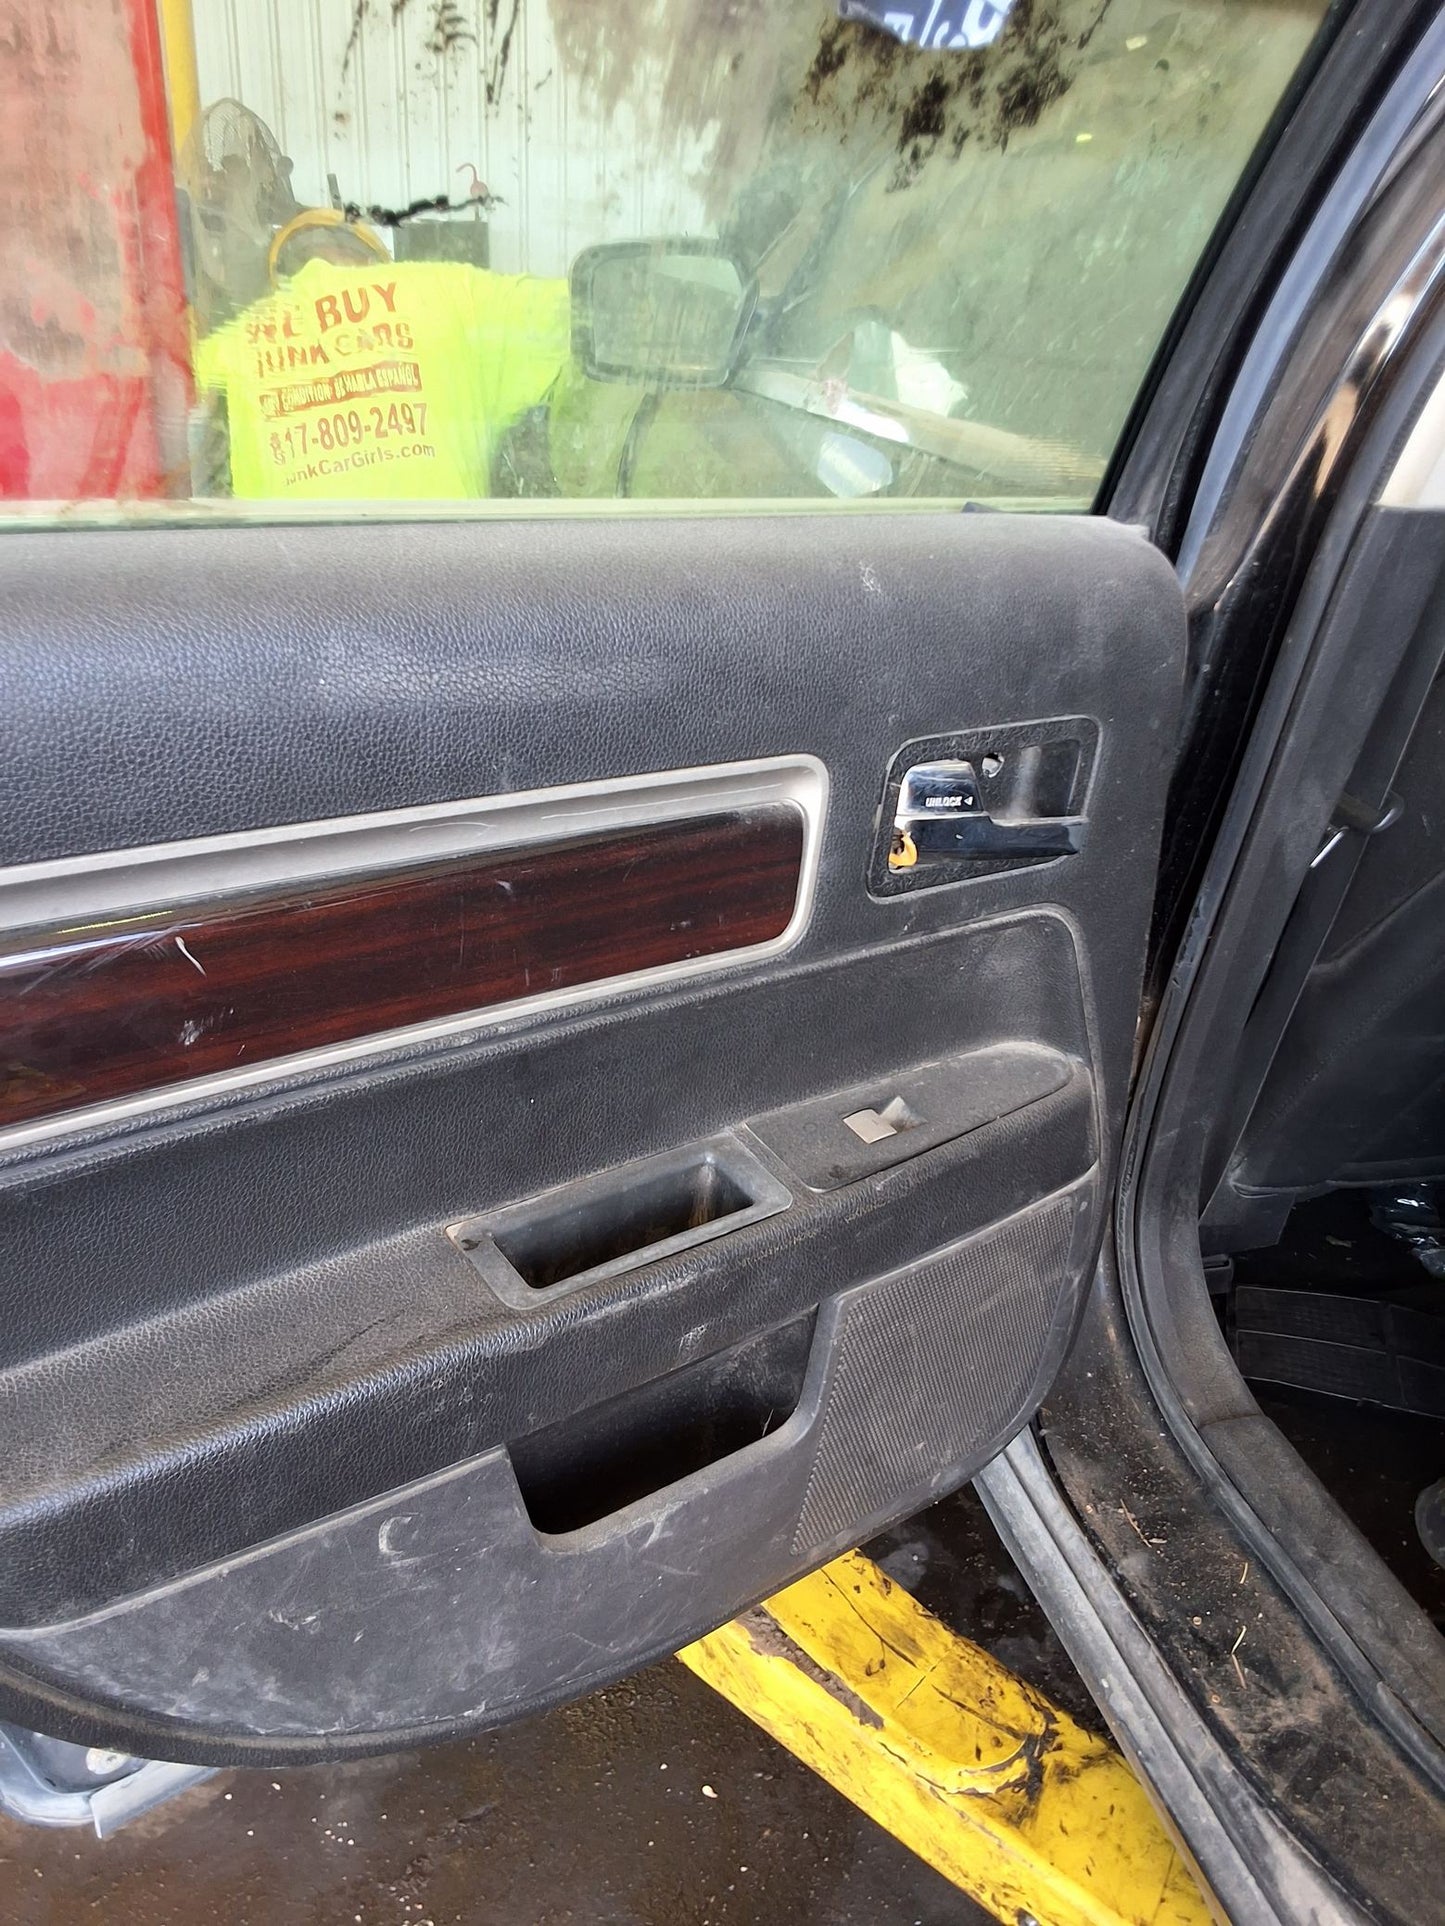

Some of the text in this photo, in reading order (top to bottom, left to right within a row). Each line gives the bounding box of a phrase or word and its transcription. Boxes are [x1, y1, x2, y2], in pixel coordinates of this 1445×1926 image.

[315, 282, 397, 333] BUY
[285, 444, 435, 486] unkCarGirls.com
[925, 796, 962, 807] UNLOCK
